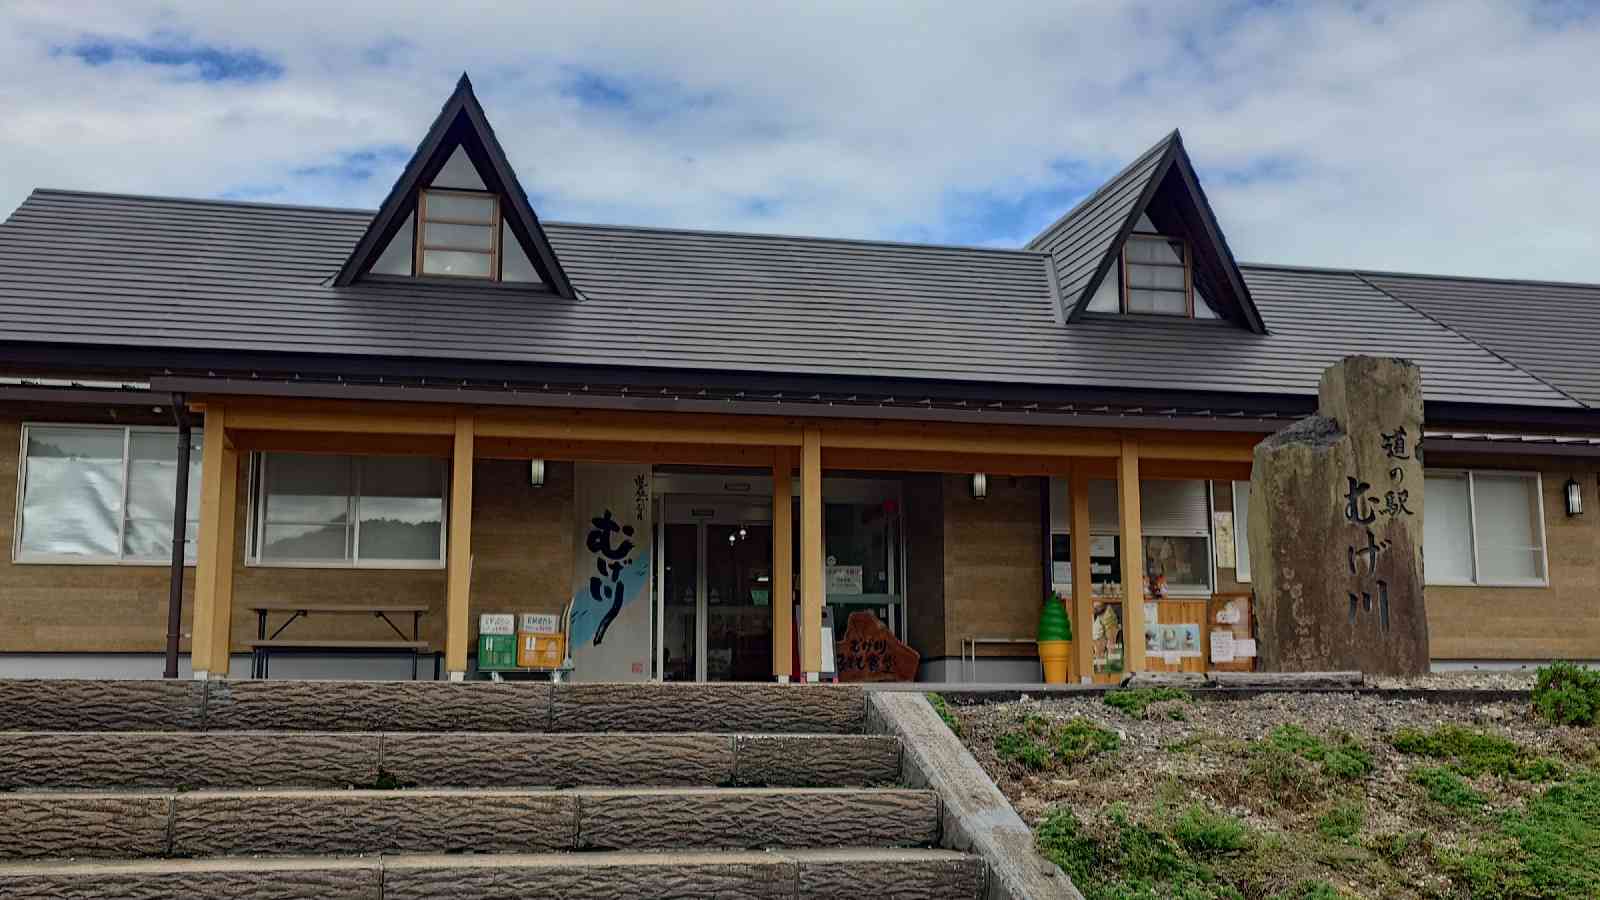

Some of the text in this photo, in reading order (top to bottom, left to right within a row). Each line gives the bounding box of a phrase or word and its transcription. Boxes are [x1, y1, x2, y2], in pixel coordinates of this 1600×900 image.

[1379, 425, 1415, 516] 道の駅
[586, 508, 636, 647] むげ川
[1343, 475, 1393, 633] むげ川
